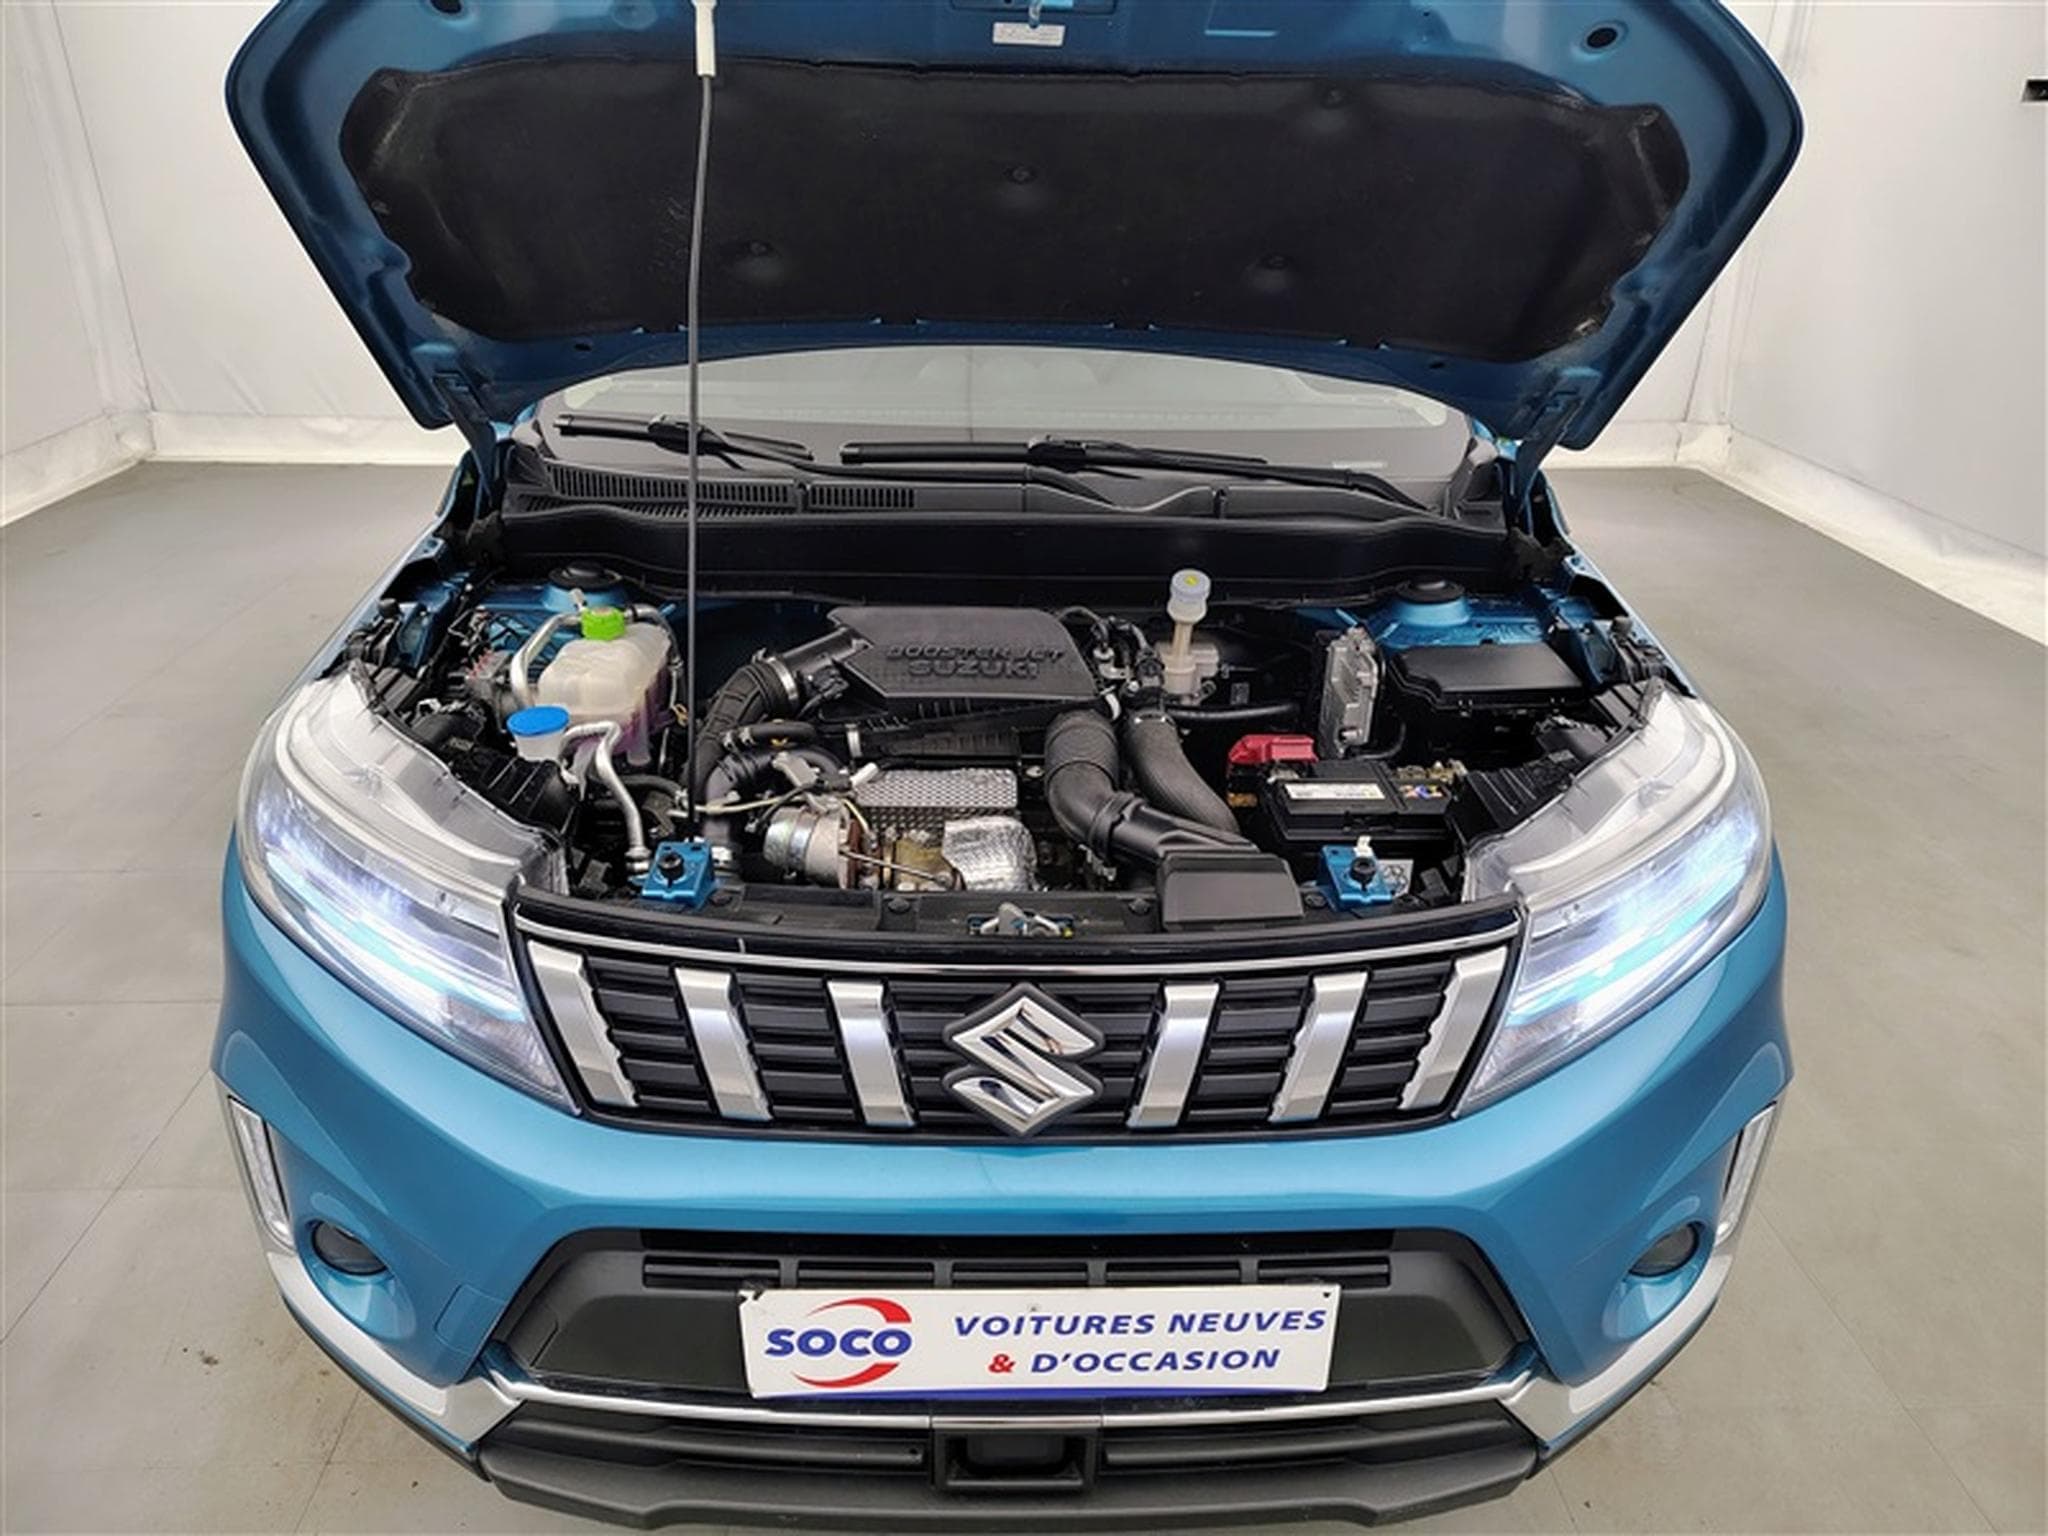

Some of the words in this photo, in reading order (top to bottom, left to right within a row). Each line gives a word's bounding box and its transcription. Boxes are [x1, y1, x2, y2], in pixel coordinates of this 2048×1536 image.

[908, 659, 1039, 679] SUZUKI
[955, 1314, 1155, 1336] VOITURES
[1167, 1310, 1326, 1333] NEUVES
[765, 1328, 913, 1357] SOCO
[987, 1354, 1014, 1374] &
[1031, 1349, 1281, 1373] D'OCCASION
